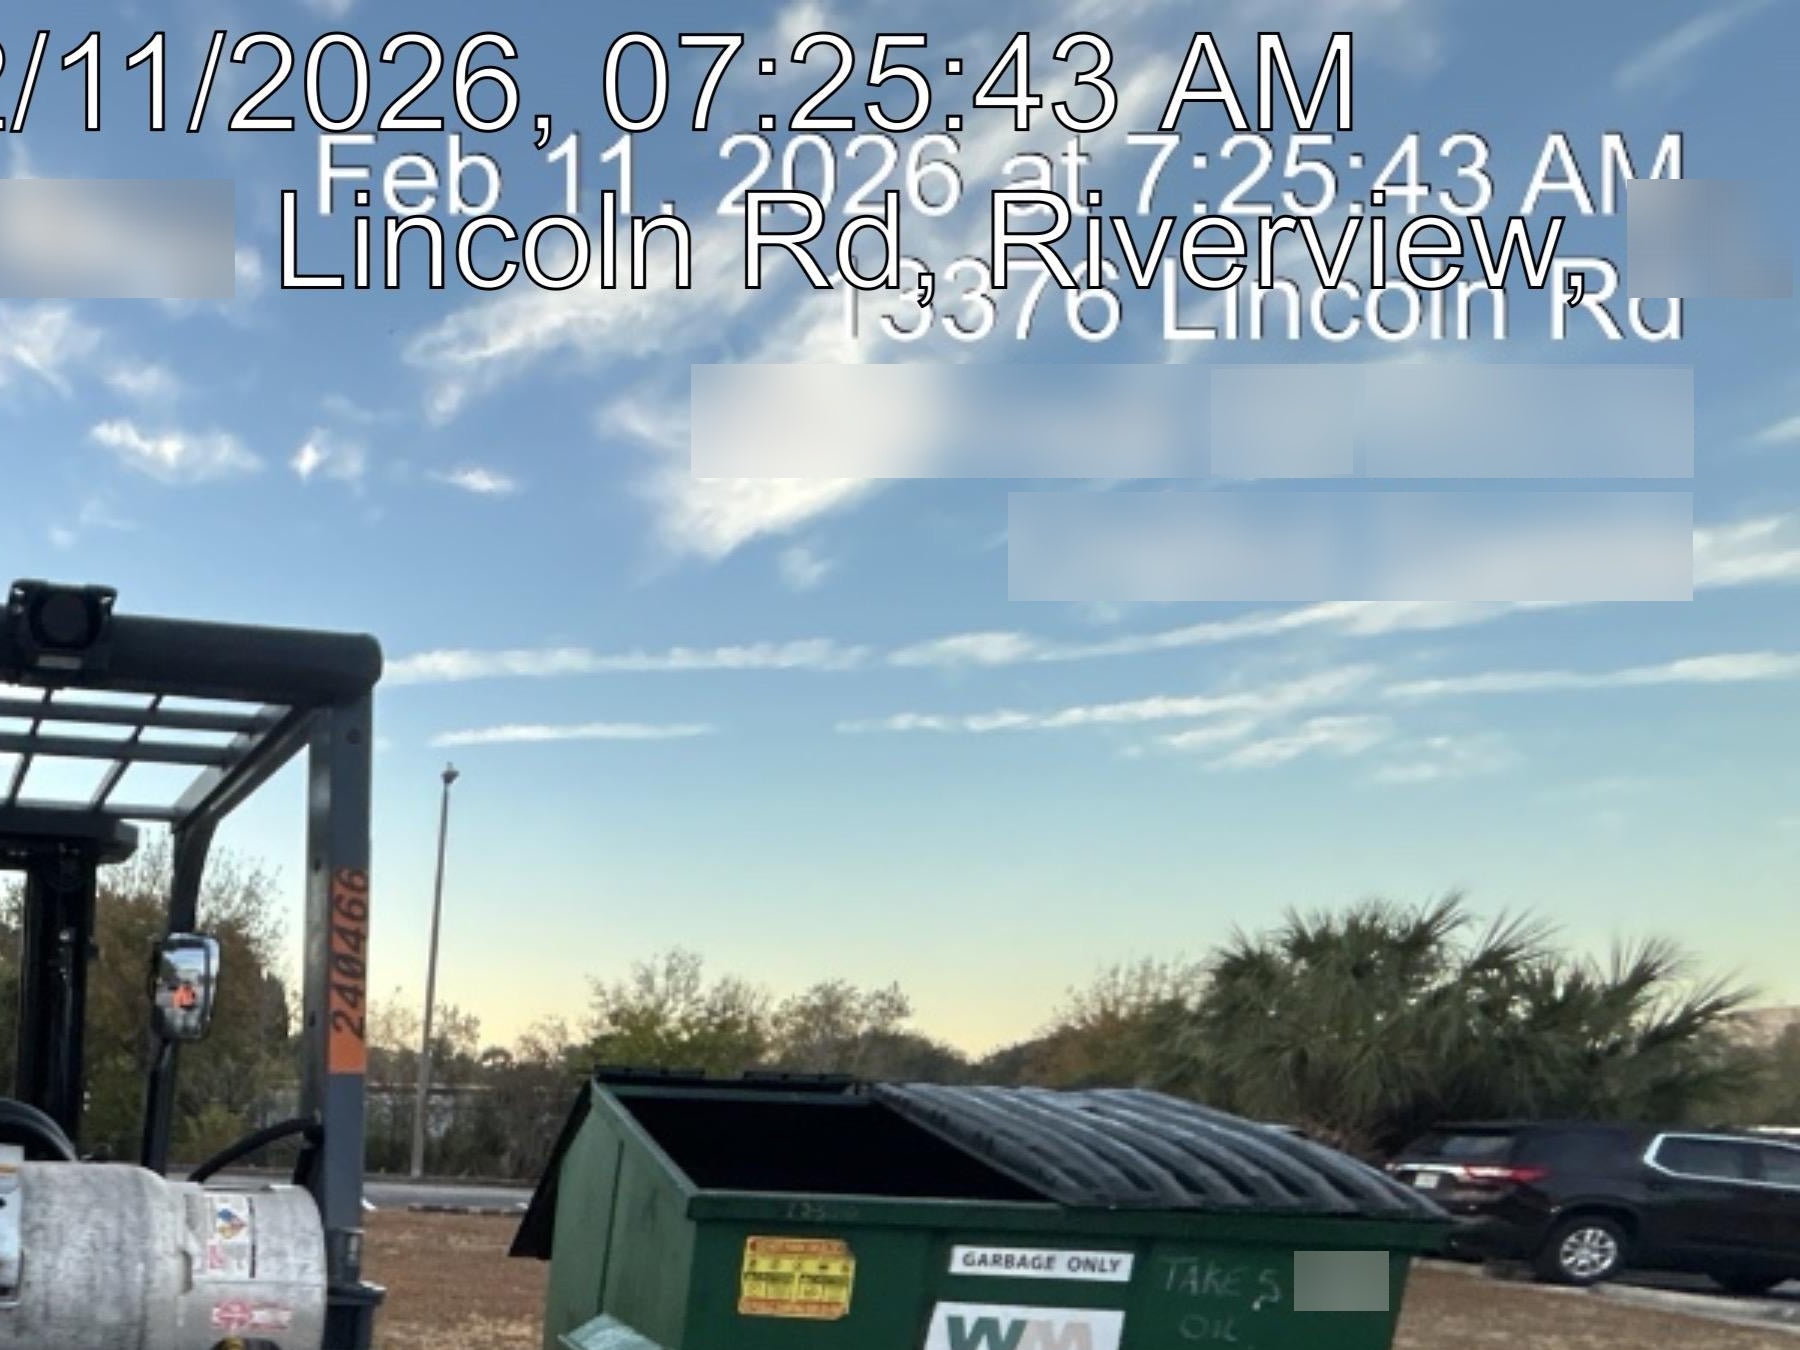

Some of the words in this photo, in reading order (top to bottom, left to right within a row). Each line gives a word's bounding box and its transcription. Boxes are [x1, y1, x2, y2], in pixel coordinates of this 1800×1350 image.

[333, 868, 369, 1040] 240466
[962, 1253, 1056, 1271] GARBAGE
[1067, 1256, 1122, 1273] ONLY
